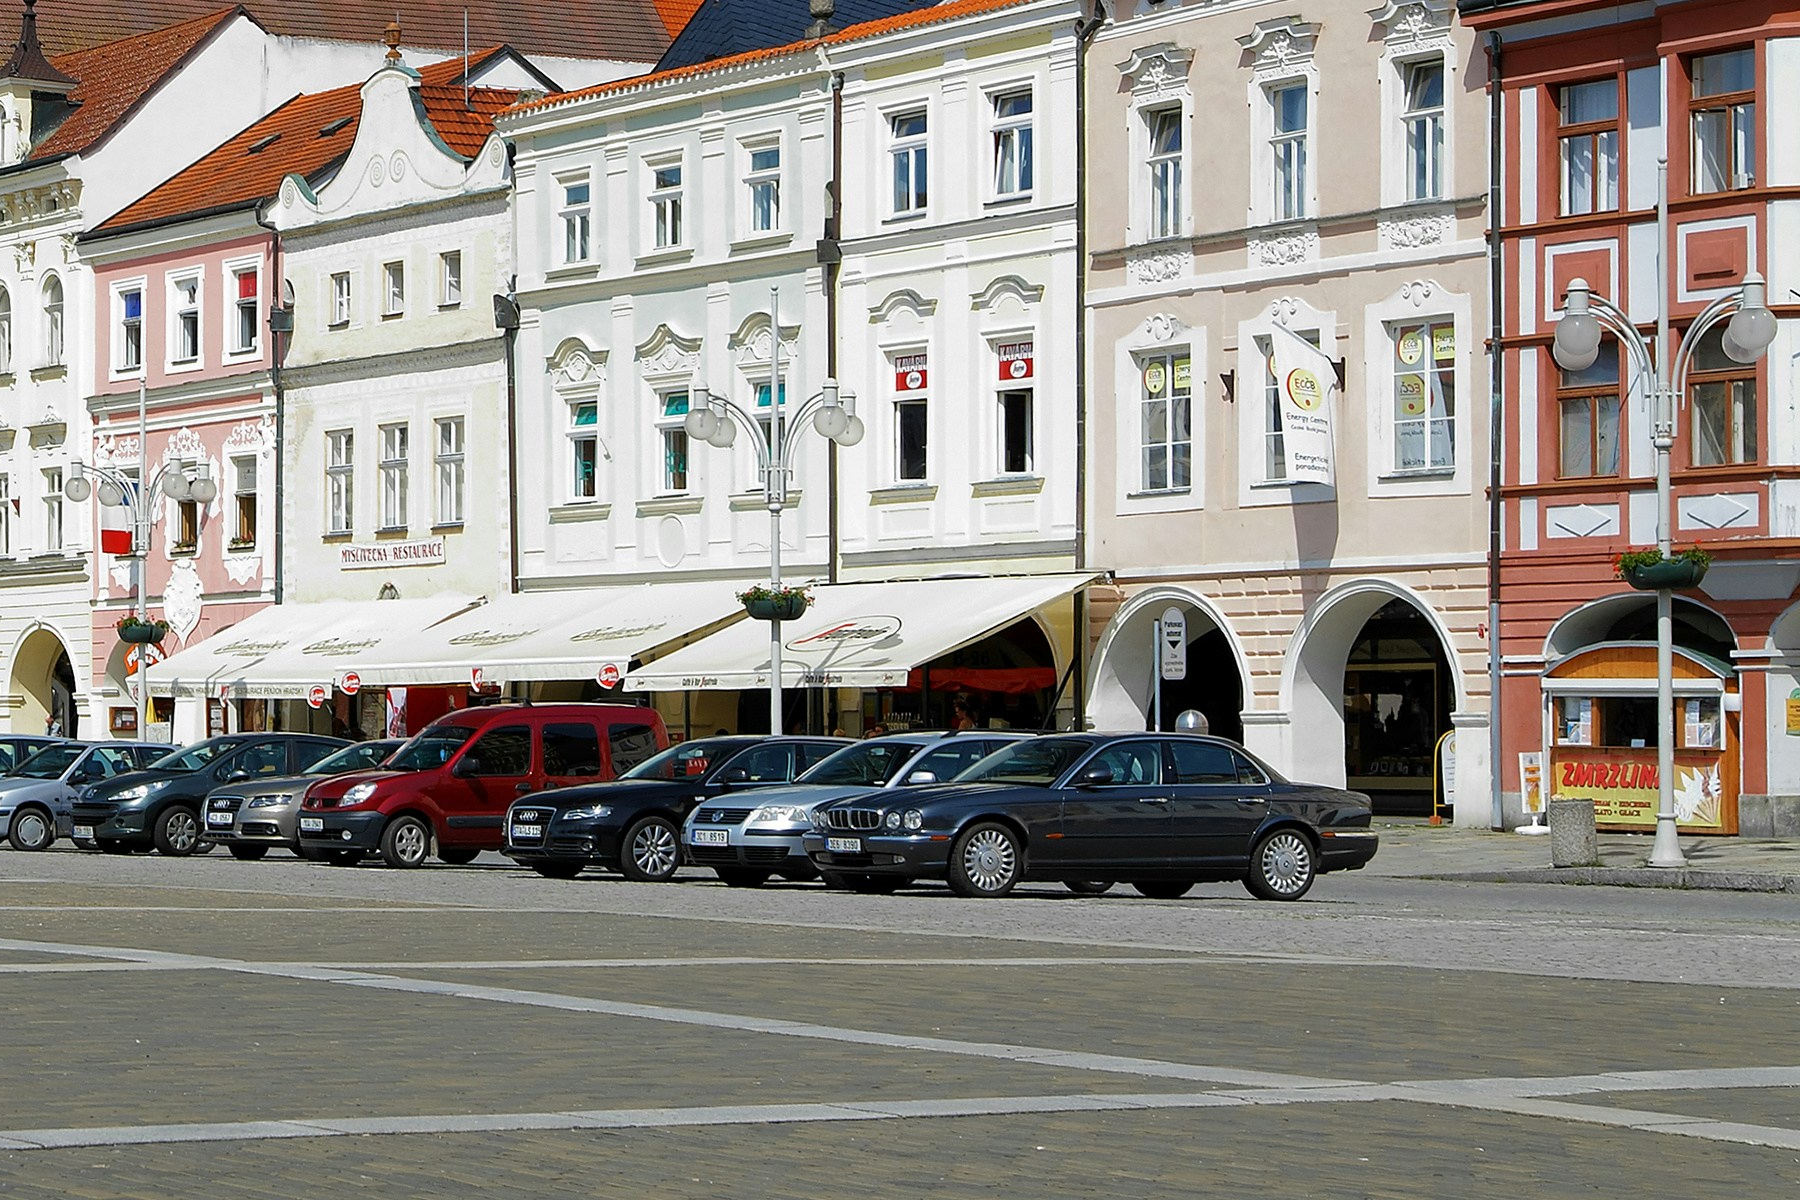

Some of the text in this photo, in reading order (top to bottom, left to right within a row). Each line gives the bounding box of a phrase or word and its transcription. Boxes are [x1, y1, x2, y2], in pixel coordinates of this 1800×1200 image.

[1294, 377, 1316, 391] ECČB
[1286, 412, 1309, 423] Energy
[127, 643, 165, 667] PERNA
